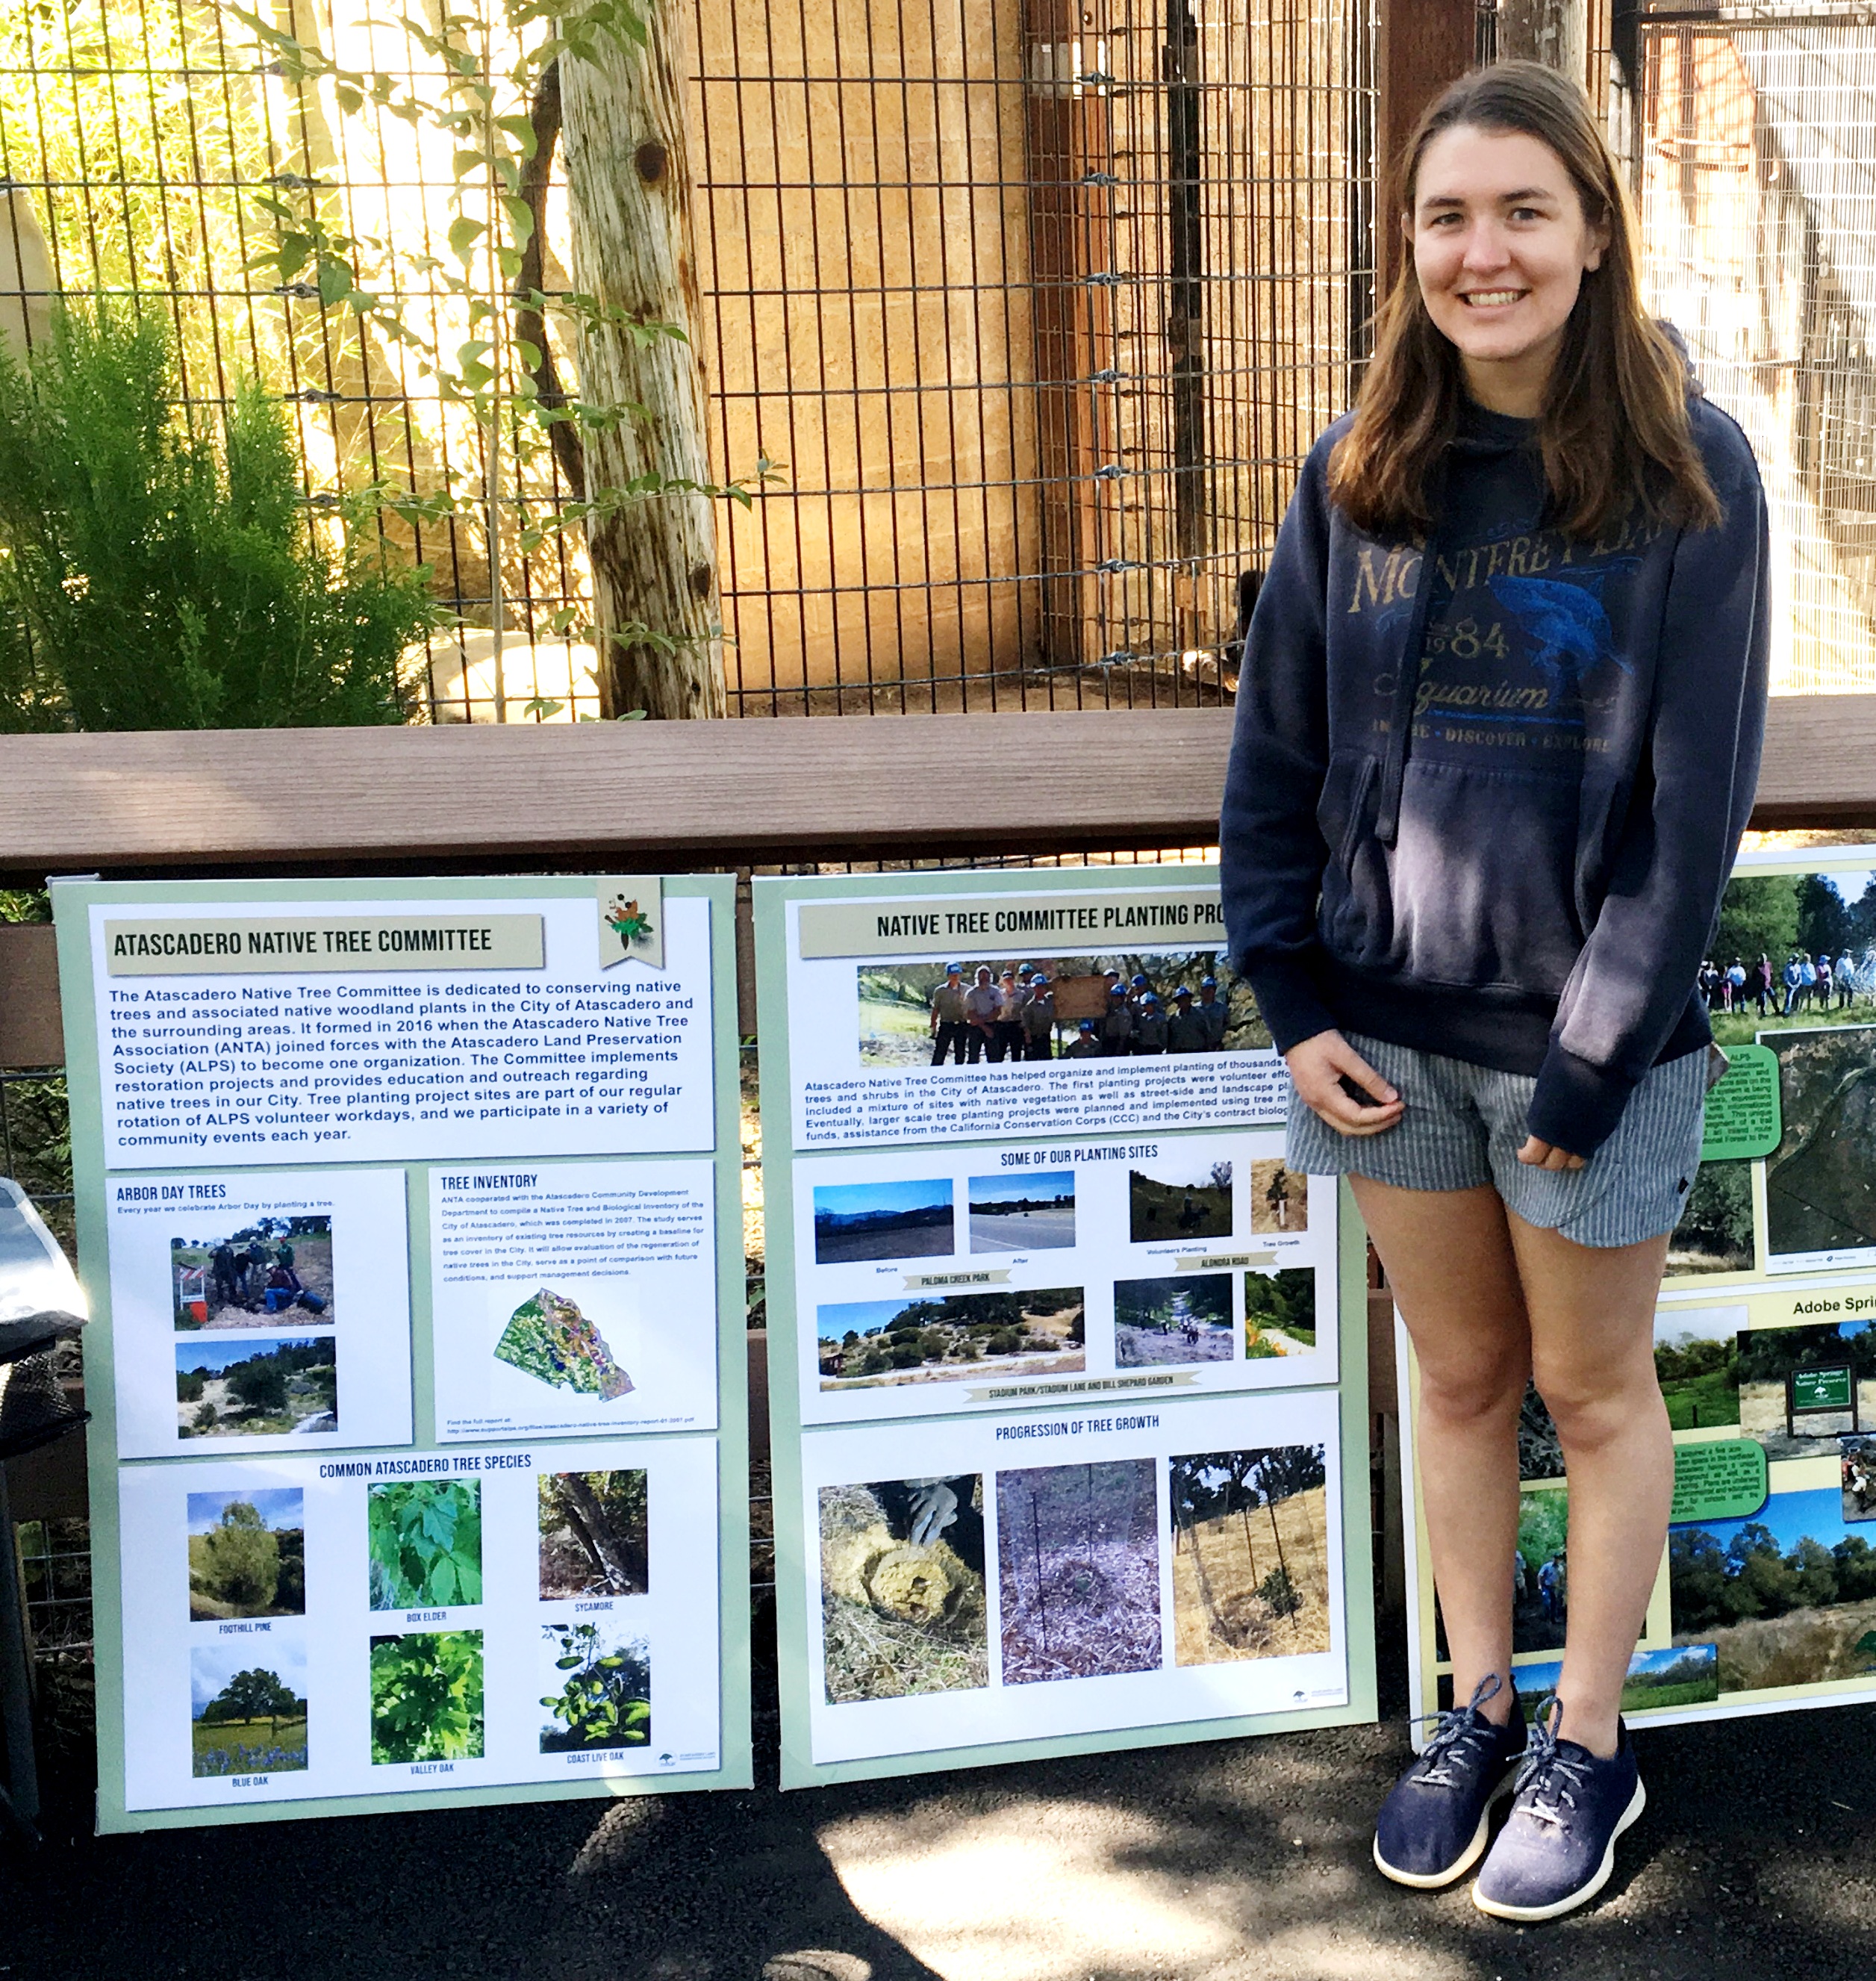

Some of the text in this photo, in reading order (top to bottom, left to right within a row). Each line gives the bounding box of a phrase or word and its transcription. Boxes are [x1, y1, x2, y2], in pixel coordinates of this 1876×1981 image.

[1445, 727, 1526, 747] DISCOVER
[877, 914, 939, 936] NATIVE
[944, 912, 989, 933] TREE
[994, 910, 1098, 931] COMMITTEE
[1103, 904, 1188, 927] PLANTING
[113, 929, 491, 955] ATASCADERO NATIVE TREE COMMITTEE
[108, 980, 681, 1001] The Atascadero Native Tree Committee is dedicated to conserving native
[110, 998, 693, 1020] trees and associated native woodland plants in the City of Atascadero and
[110, 1015, 688, 1038] the surrounding areas. It formed in 2016 when the Atascadero Native Tree
[1730, 1053, 1751, 1061] ALPS
[804, 1080, 866, 1090] Atascadero
[868, 1079, 902, 1087] Native
[904, 1077, 927, 1085] Tree
[929, 1075, 987, 1084] Committee
[1011, 1070, 1046, 1080] helped
[1048, 1069, 1093, 1079] organize
[1095, 1066, 1115, 1075] and
[1117, 1065, 1171, 1075] implement
[1173, 1063, 1214, 1073] planting
[1216, 1060, 1227, 1069] of
[1229, 1058, 1283, 1069] thousands
[805, 1095, 832, 1104] trees
[837, 1092, 857, 1101] and
[861, 1091, 899, 1100] shrubs
[918, 1088, 936, 1097] the
[941, 1087, 962, 1097] City
[966, 1085, 977, 1095] of
[981, 1083, 1044, 1093] Atascadero.
[1048, 1081, 1068, 1089] The
[1072, 1080, 1094, 1089] first
[1098, 1079, 1140, 1089] planting
[1144, 1076, 1186, 1086] projects
[1219, 1072, 1267, 1081] volunteer
[1000, 1144, 1158, 1166] SOME OF OUR PLANTING SITES
[440, 1174, 537, 1189] TREE INVENTORY
[116, 1184, 225, 1201] ARBOR DAY TREES
[116, 1206, 141, 1214] Every
[143, 1206, 161, 1214] year
[243, 1202, 259, 1210] Day
[261, 1201, 271, 1210] by
[273, 1201, 308, 1209] planting
[1182, 1245, 1207, 1254] Planting
[1793, 1299, 1840, 1315] Adobe
[996, 1415, 1159, 1439] PROGRESSION OF TREE GROWTH
[320, 1455, 531, 1478] COMMON ATASCADERO TREE SPECIES
[575, 1601, 614, 1612] SYCAMORE
[407, 1611, 446, 1623] BOX ELDER
[219, 1622, 272, 1634] FOOTHILL PINE
[567, 1751, 624, 1764] COAST LIVE OAK
[411, 1764, 455, 1775] VALLEY OAK
[232, 1776, 269, 1788] BLUE OAK
